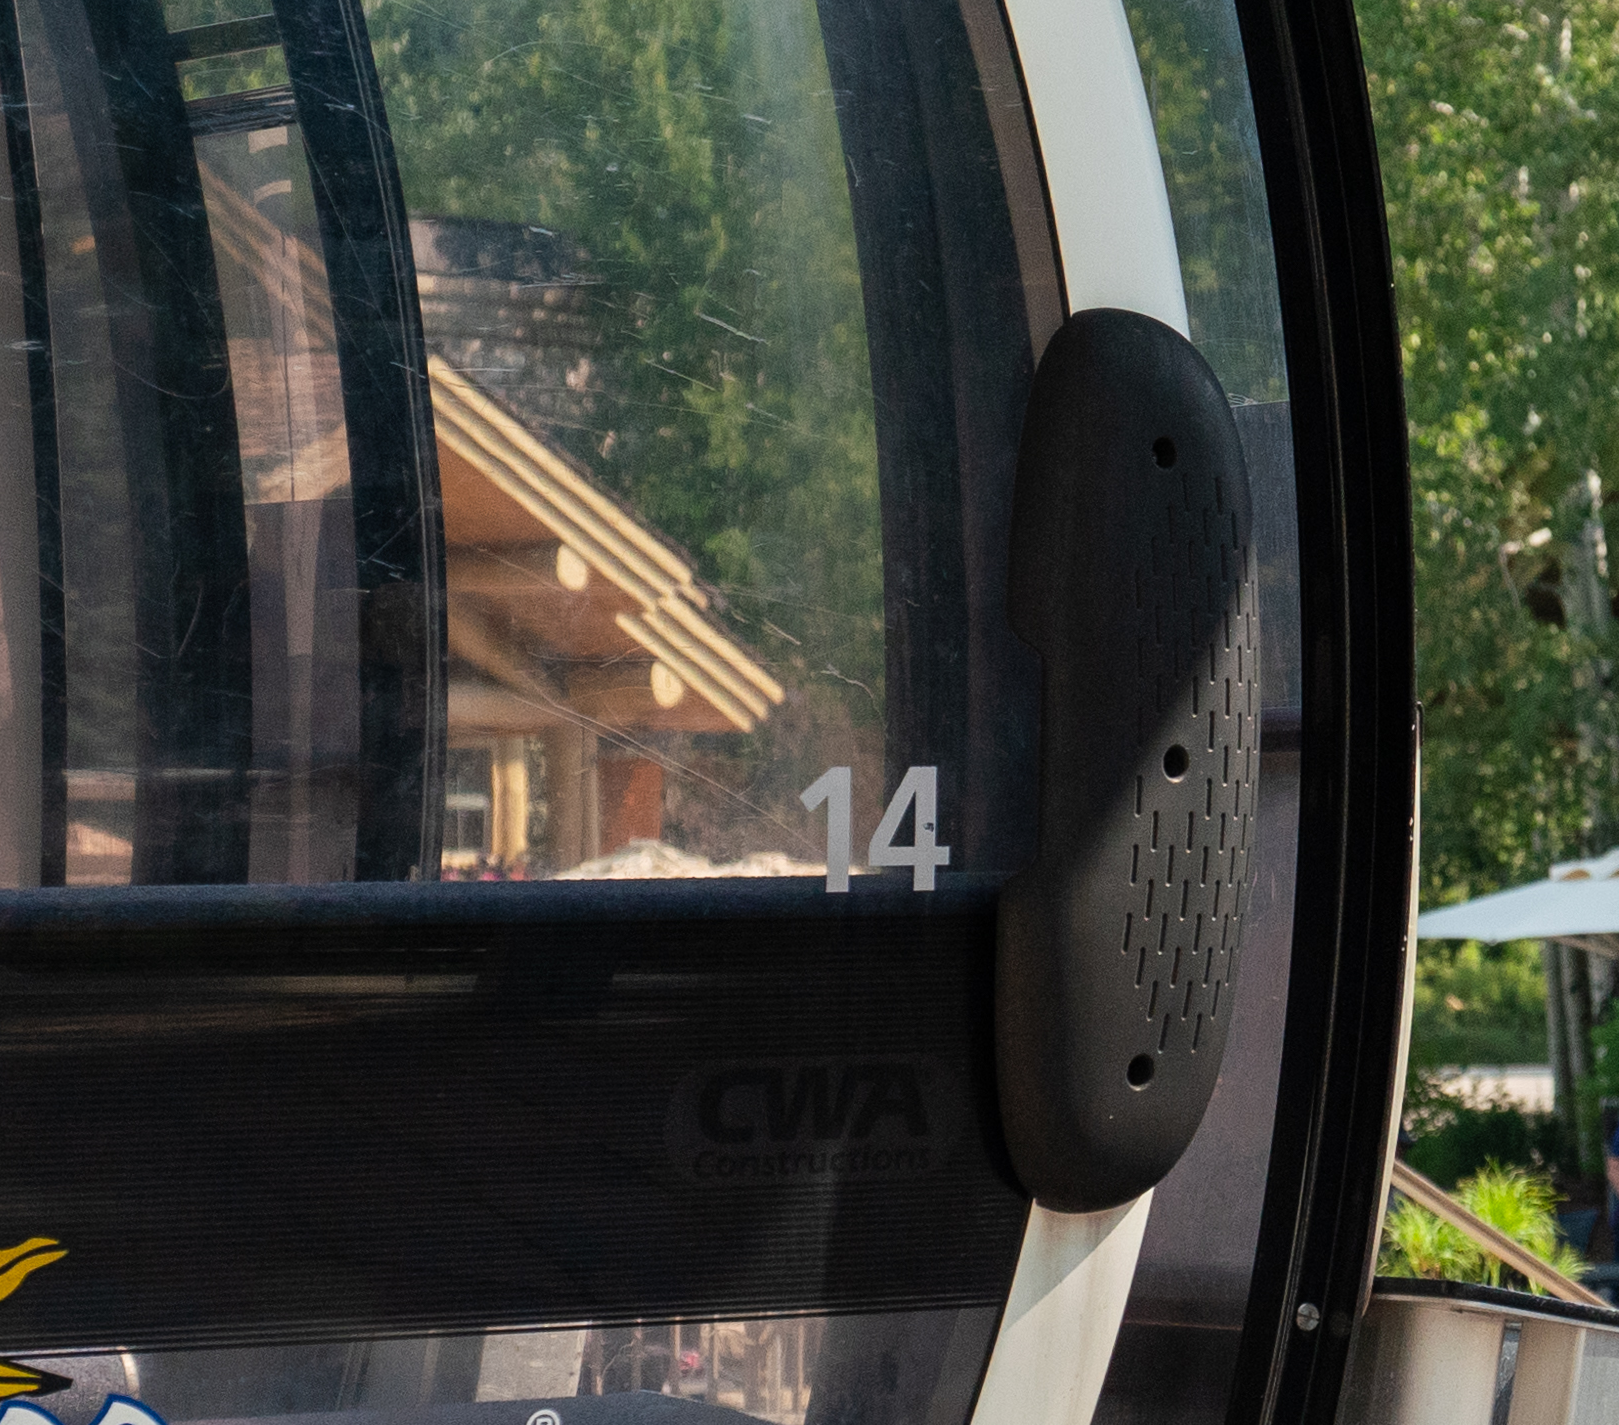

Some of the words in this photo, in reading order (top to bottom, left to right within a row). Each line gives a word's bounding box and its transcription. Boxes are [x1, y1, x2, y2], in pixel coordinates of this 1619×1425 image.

[799, 765, 950, 893] 14
[698, 1063, 930, 1143] CWA
[693, 1146, 931, 1179] Constructions
